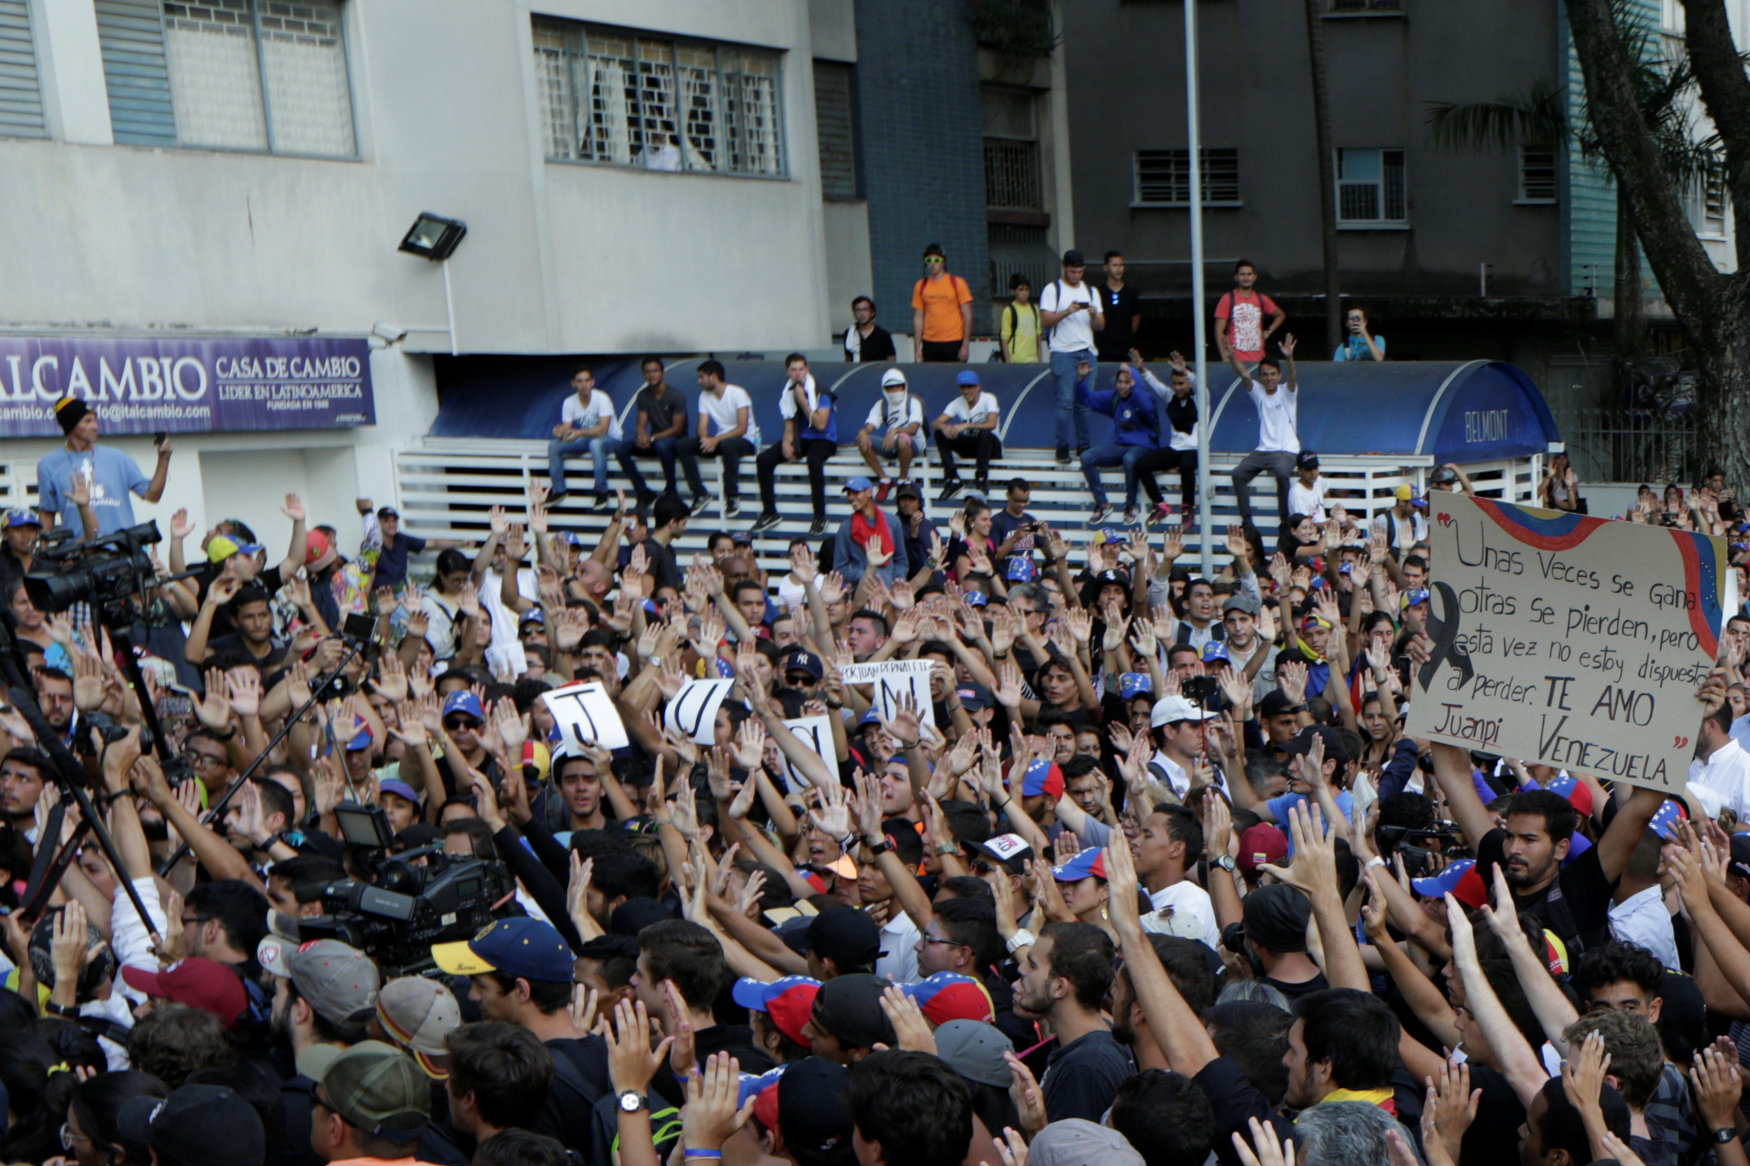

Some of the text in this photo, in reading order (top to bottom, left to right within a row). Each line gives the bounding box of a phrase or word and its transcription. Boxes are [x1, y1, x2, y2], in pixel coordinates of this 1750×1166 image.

[216, 356, 361, 379] CASA DE CAMBIO
[1465, 410, 1508, 443] BELMONT
[1458, 576, 1517, 616] otras
[1659, 629, 1700, 652] pero
[1453, 623, 1708, 689] esta vez no estoy dispuesto
[675, 683, 719, 738] U
[1544, 676, 1576, 711] TE
[1590, 685, 1655, 726] AMO
[1434, 702, 1669, 785] Juanpi VENEZUELA
